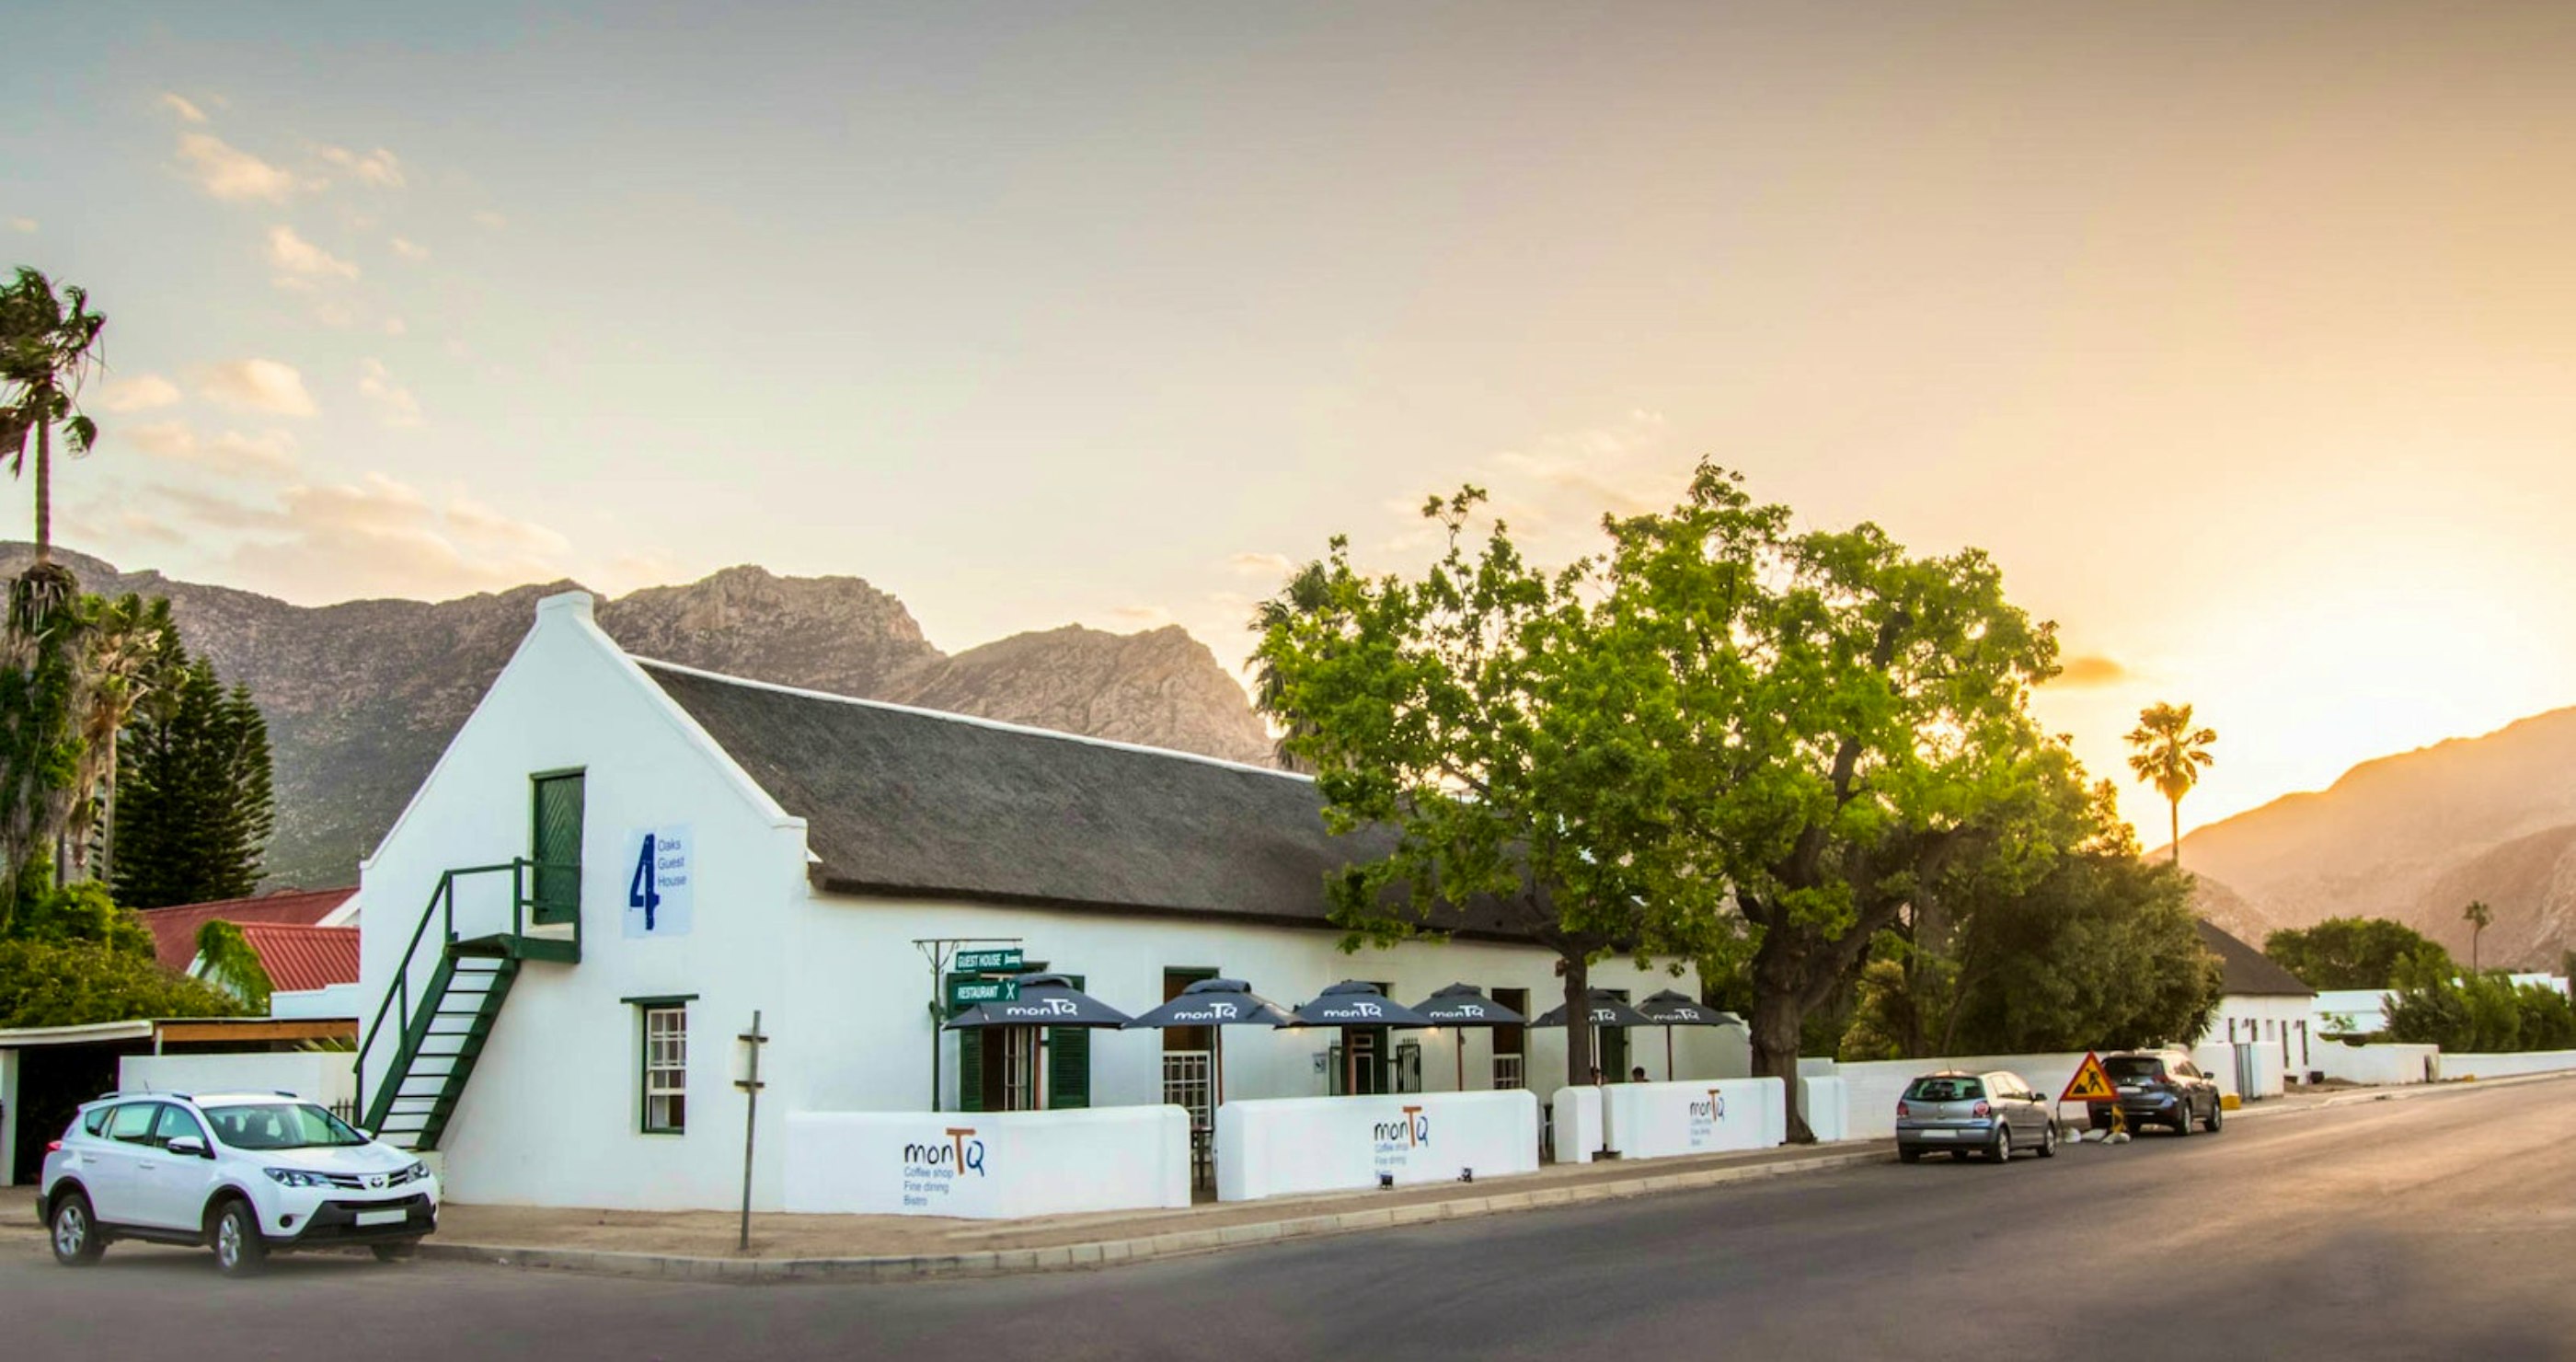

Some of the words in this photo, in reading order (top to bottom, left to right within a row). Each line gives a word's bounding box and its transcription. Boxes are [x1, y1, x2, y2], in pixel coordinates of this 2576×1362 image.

[658, 839, 681, 851] Oaks
[658, 858, 684, 870] Guest
[630, 834, 660, 930] 4
[658, 876, 686, 886] House
[958, 986, 998, 999] RESTAURANT
[904, 1166, 931, 1177] Coffee
[933, 1168, 953, 1179] shop
[904, 1181, 921, 1191] Fine
[924, 1182, 949, 1195] dining
